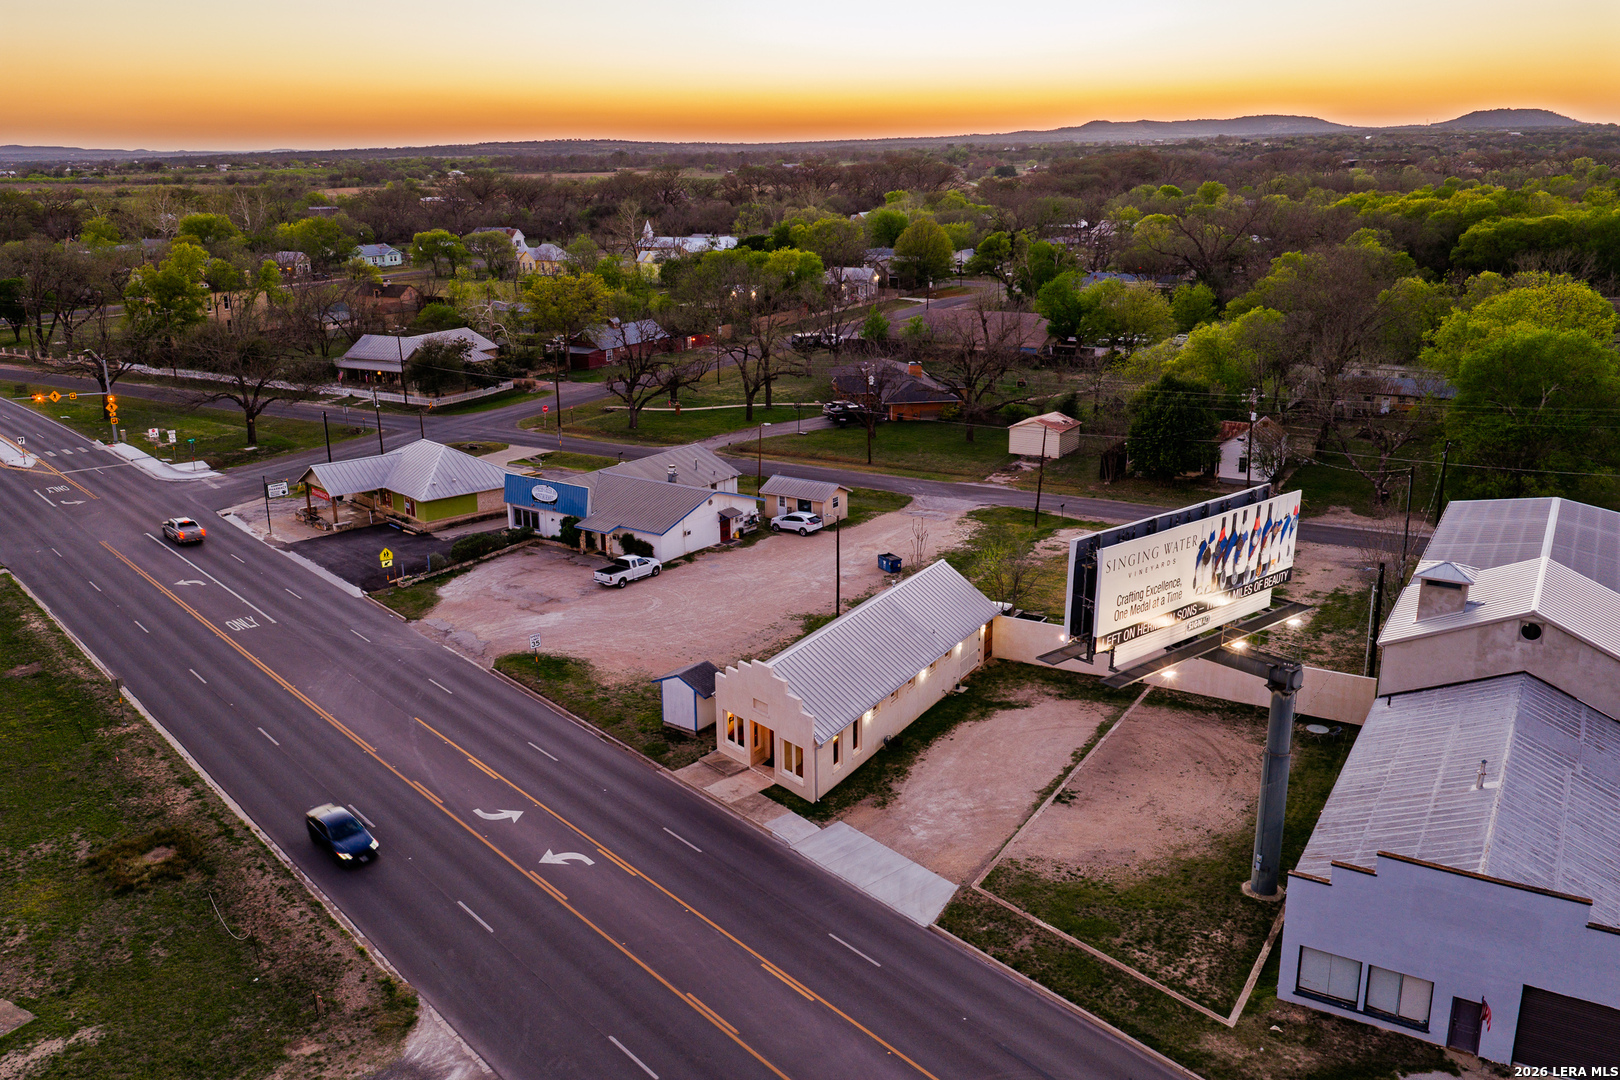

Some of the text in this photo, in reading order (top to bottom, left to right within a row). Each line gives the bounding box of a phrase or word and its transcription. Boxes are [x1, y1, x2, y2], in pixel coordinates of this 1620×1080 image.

[45, 485, 70, 494] ONLY
[1105, 534, 1198, 574] SINGING WATER
[1127, 558, 1177, 579] VINEYARDS
[1116, 577, 1183, 607] Crafting Excellence,
[1101, 632, 1122, 647] LEFT
[1123, 626, 1136, 642] ON
[1177, 604, 1198, 620] SONS
[1232, 584, 1253, 600] MILES
[1253, 579, 1264, 591] OF
[1264, 571, 1289, 588] BEAUTY
[1113, 590, 1183, 622] One Medal at a Time
[225, 615, 260, 631] ONLY
[531, 640, 541, 648] 35
